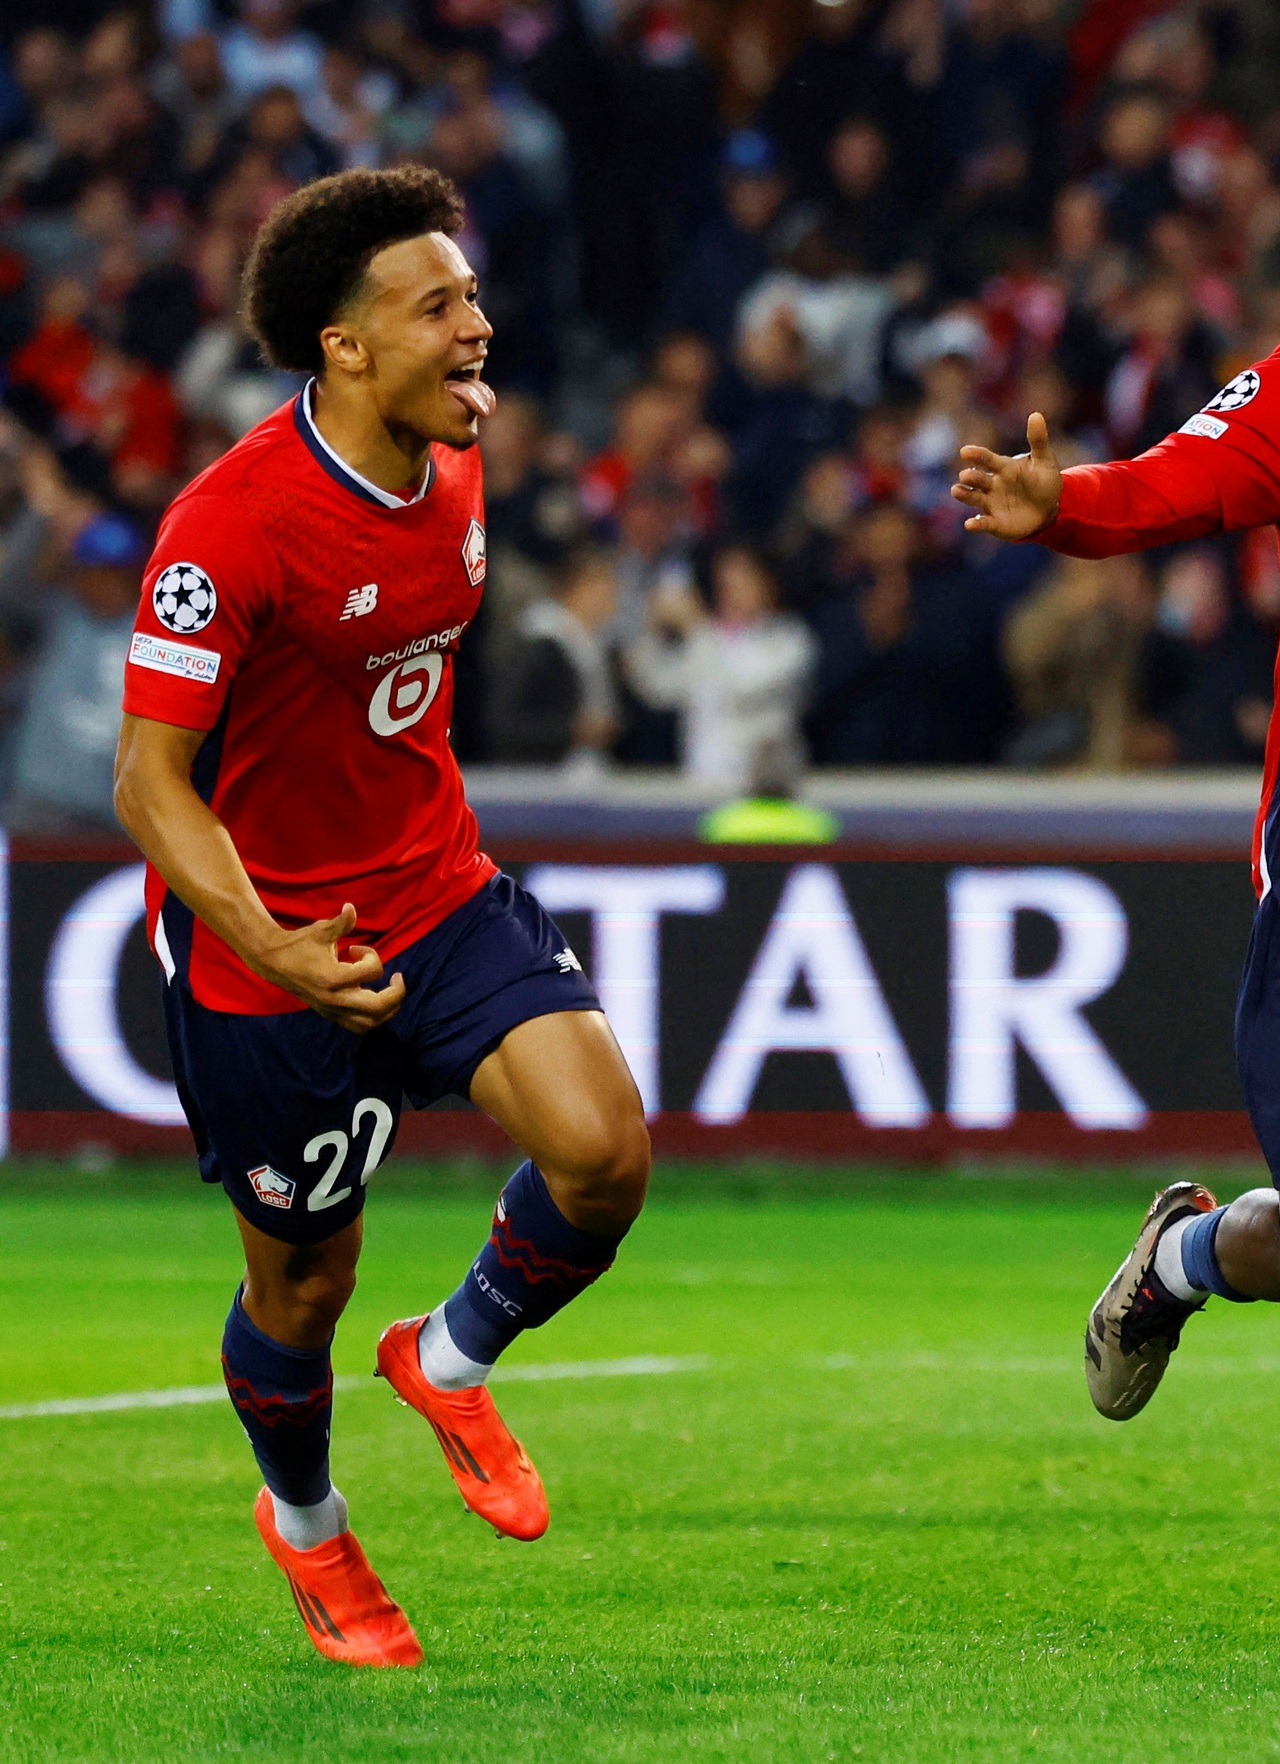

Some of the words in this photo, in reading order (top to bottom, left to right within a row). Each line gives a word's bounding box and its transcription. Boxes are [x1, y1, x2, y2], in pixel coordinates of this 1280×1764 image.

[132, 643, 218, 673] FOUNDATION
[365, 620, 468, 670] boulanger
[303, 1097, 393, 1212] 22
[260, 1192, 287, 1206] LOSC
[473, 1260, 523, 1317] LOSC
